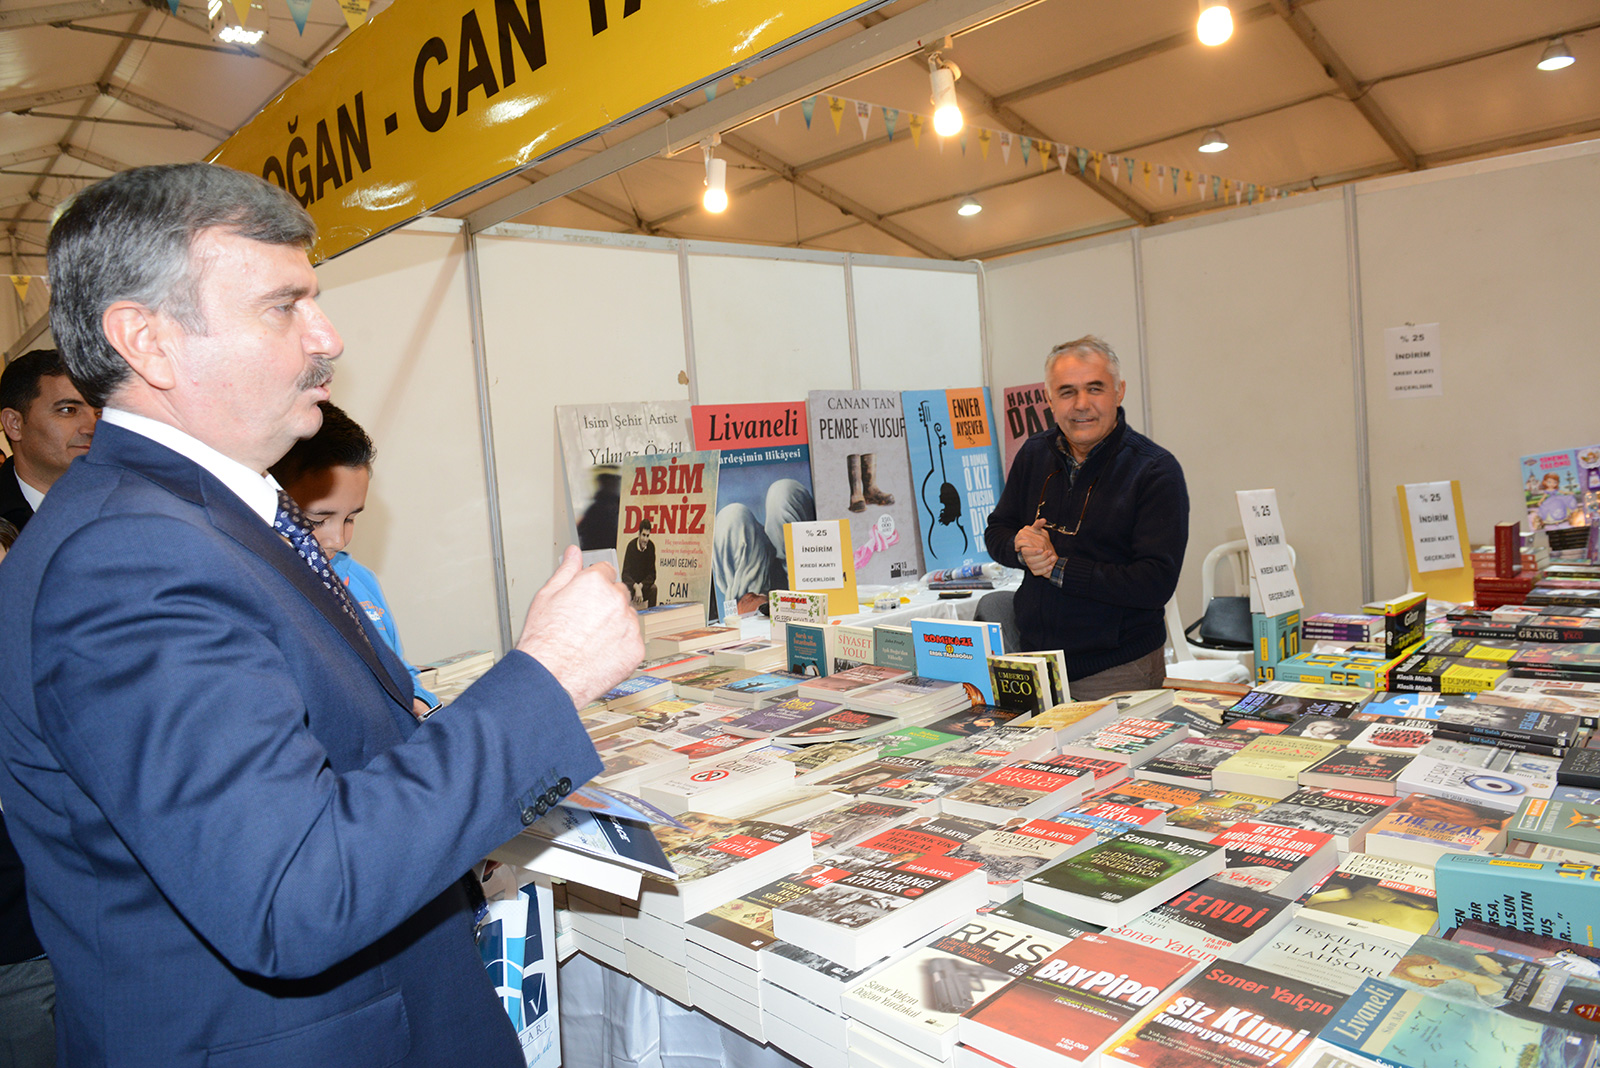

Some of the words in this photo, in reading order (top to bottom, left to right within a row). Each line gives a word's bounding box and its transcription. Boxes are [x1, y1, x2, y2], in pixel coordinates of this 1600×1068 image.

[263, 91, 372, 208] OĞAN
[413, 0, 547, 133] CAN
[1400, 335, 1409, 343] %
[1412, 333, 1425, 342] 25
[1395, 351, 1431, 360] İNDİRİM
[827, 397, 870, 410] CANAN
[871, 398, 895, 410] TAN
[952, 398, 981, 418] ENVER
[584, 414, 609, 429] İsim
[614, 413, 642, 429] Şehir
[649, 412, 678, 425] Artist
[708, 408, 799, 442] Livaneli
[956, 420, 984, 437] AYSEVER
[819, 420, 859, 440] PEMBE
[718, 451, 763, 466] ardeşimin
[764, 448, 801, 463] Hikâyesi
[630, 456, 705, 495] ABİM
[974, 465, 992, 489] KIZ
[1419, 493, 1428, 503] %
[1429, 492, 1441, 502] 25
[623, 495, 707, 534] DENİZ
[1252, 505, 1260, 517] %
[1260, 504, 1271, 517] 25
[1419, 514, 1449, 523] İNDİRİM
[816, 528, 828, 537] 25
[1254, 533, 1280, 547] İNDİRİM
[801, 545, 833, 554] İNDİRİM
[660, 557, 677, 568] HAMDİ
[678, 556, 698, 568] GEZMİŞ
[669, 582, 689, 598] CAN
[838, 632, 872, 649] SİYASET
[1518, 630, 1559, 640] GRANGÉ
[842, 646, 867, 660] YOLU
[998, 671, 1030, 681] UMBERTO
[1001, 679, 1032, 696] ECO
[1025, 763, 1051, 772] TAHA
[1048, 766, 1081, 776] AKYOL
[1327, 790, 1354, 800] TAHA
[1354, 795, 1389, 804] AKYOL
[1097, 803, 1130, 813] TAHA
[1287, 798, 1372, 815] LOZAN
[1099, 810, 1144, 825] AKYOL
[1395, 814, 1432, 826] THE
[922, 824, 945, 834] TAHA
[943, 830, 973, 841] AKYOL
[1021, 826, 1046, 835] TAHA
[1046, 831, 1077, 842] AKYOL
[1252, 825, 1299, 839] BEYAZ
[1119, 833, 1163, 848] Soner
[1163, 841, 1208, 858] Yalçın
[1220, 831, 1317, 853] MÜSLÜMANLARIN
[1223, 840, 1267, 855] BÜYÜK
[1264, 850, 1306, 862] SIRRI
[858, 868, 892, 880] AMA
[893, 873, 941, 889] HANGİ
[905, 864, 928, 873] TAHA
[927, 868, 954, 878] AKYOL
[1229, 871, 1272, 887] Yalçın
[776, 881, 812, 894] TÜRKİY
[811, 875, 834, 886] TAH
[843, 875, 909, 893] ATATÜRK
[1380, 879, 1412, 890] Soner
[1413, 885, 1437, 897] Yalç
[1169, 890, 1270, 928] FENDİ
[1488, 899, 1501, 926] RSA,
[1521, 891, 1535, 934] AYATIN
[1110, 923, 1162, 944] Soner
[1163, 938, 1218, 963] Yalçın
[864, 980, 893, 994] Soner
[890, 988, 919, 1006] Yalçın
[1205, 968, 1269, 994] Soner
[1269, 985, 1335, 1016] Yalçın
[880, 996, 922, 1018] Yurdakul
[1333, 984, 1395, 1041] Livaneli
[520, 1019, 548, 1047] LARI
[1166, 996, 1215, 1023] Siz
[1210, 1006, 1311, 1053] Kimi
